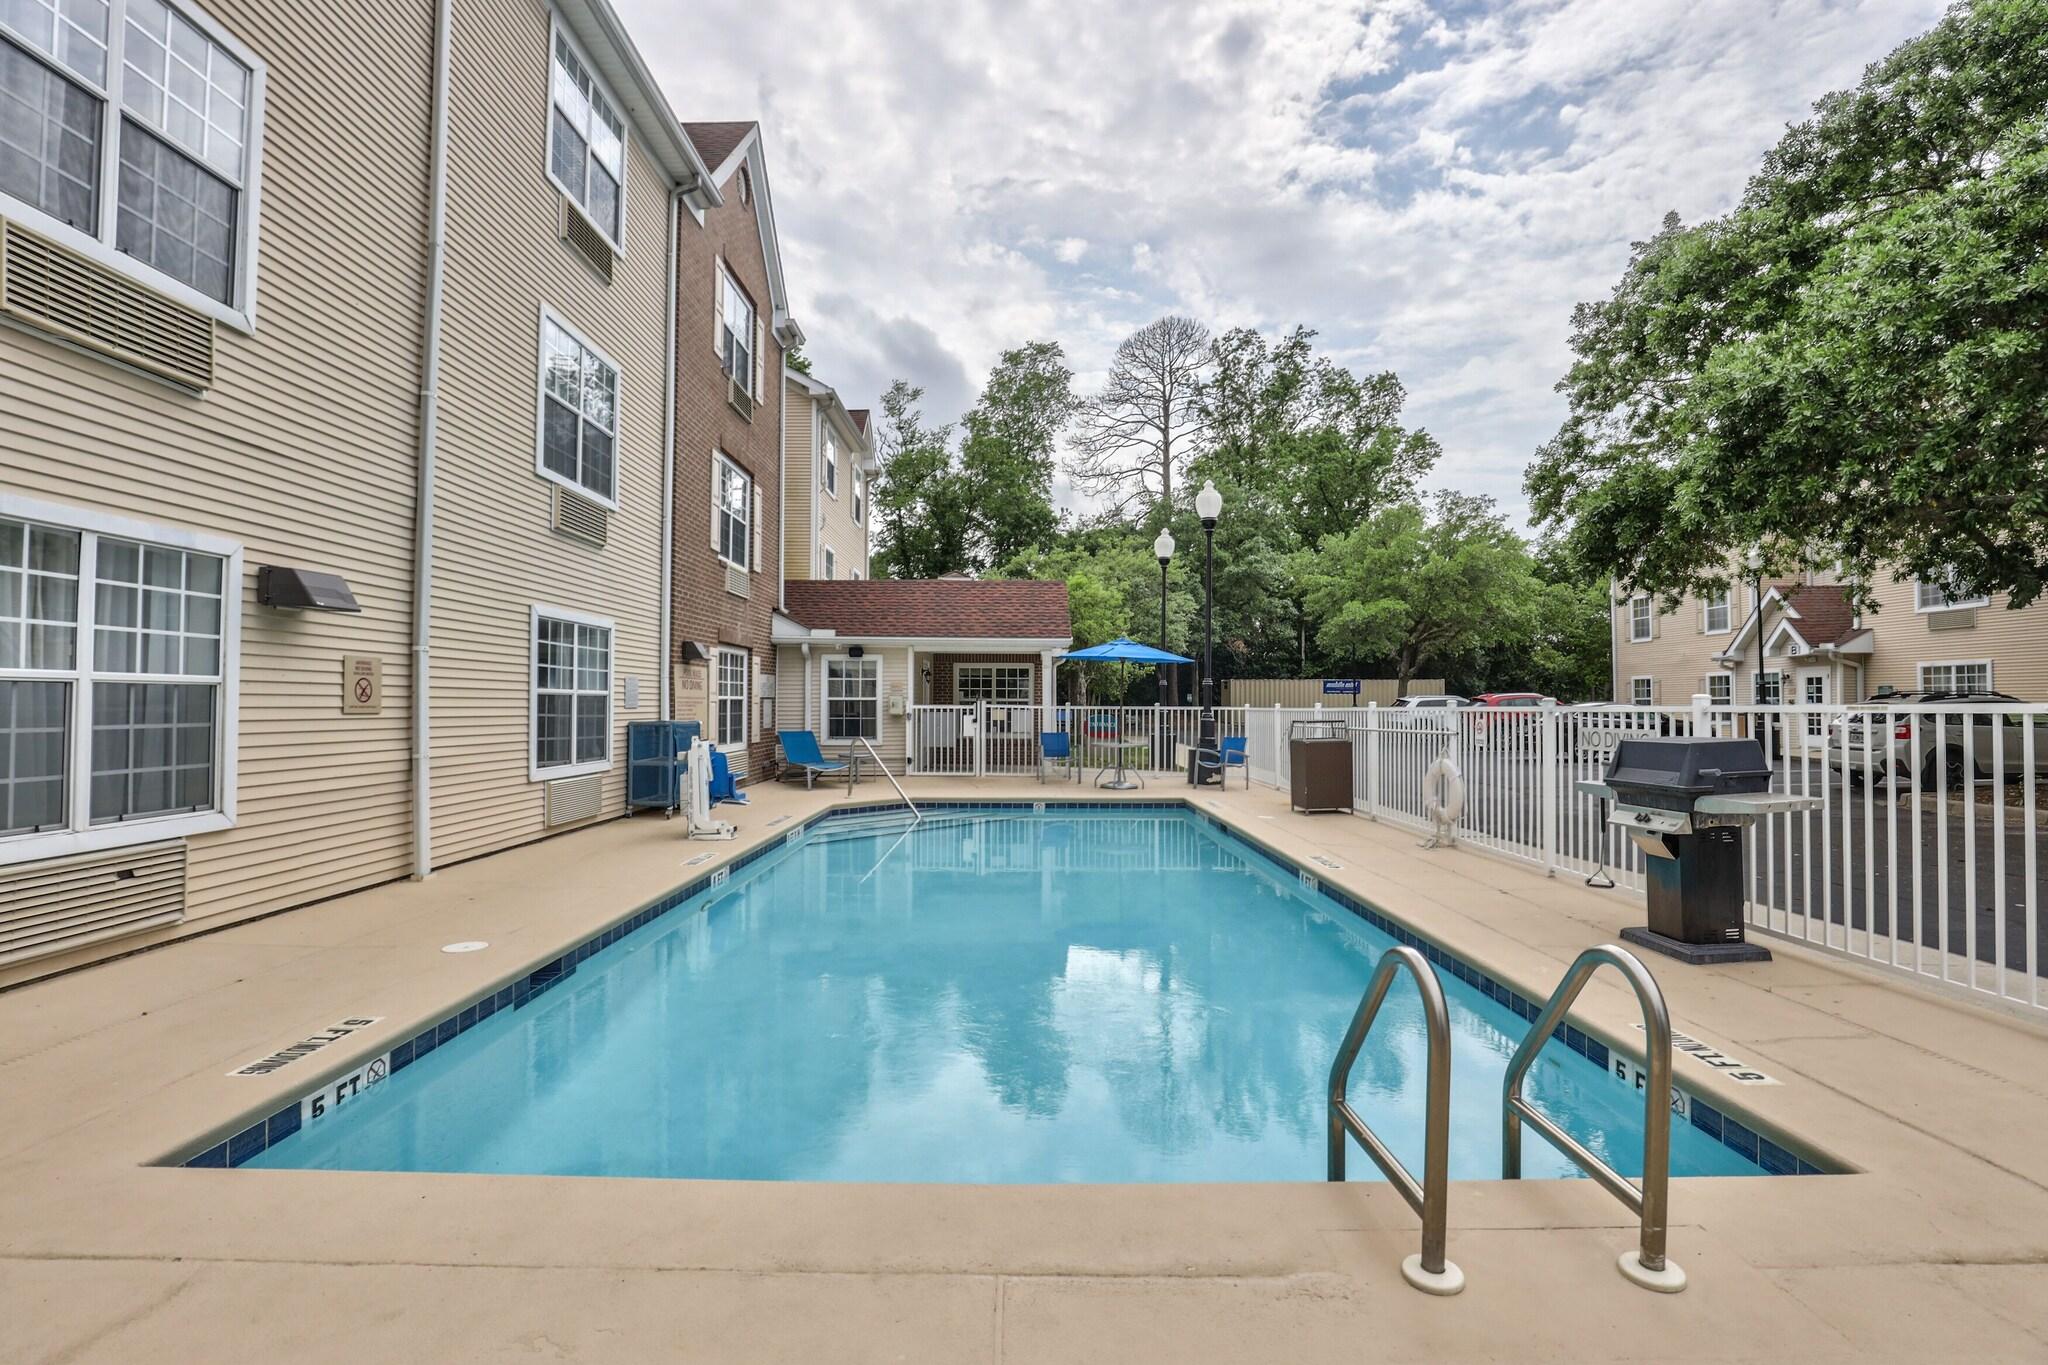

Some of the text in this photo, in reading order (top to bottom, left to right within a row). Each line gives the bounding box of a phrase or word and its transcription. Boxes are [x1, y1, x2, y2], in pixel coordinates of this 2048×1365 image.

[1581, 730, 1601, 748] NO
[343, 1018, 374, 1026] 5
[1616, 1059, 1647, 1090] 5 F
[1729, 1072, 1766, 1081] 5
[311, 1094, 325, 1119] 5
